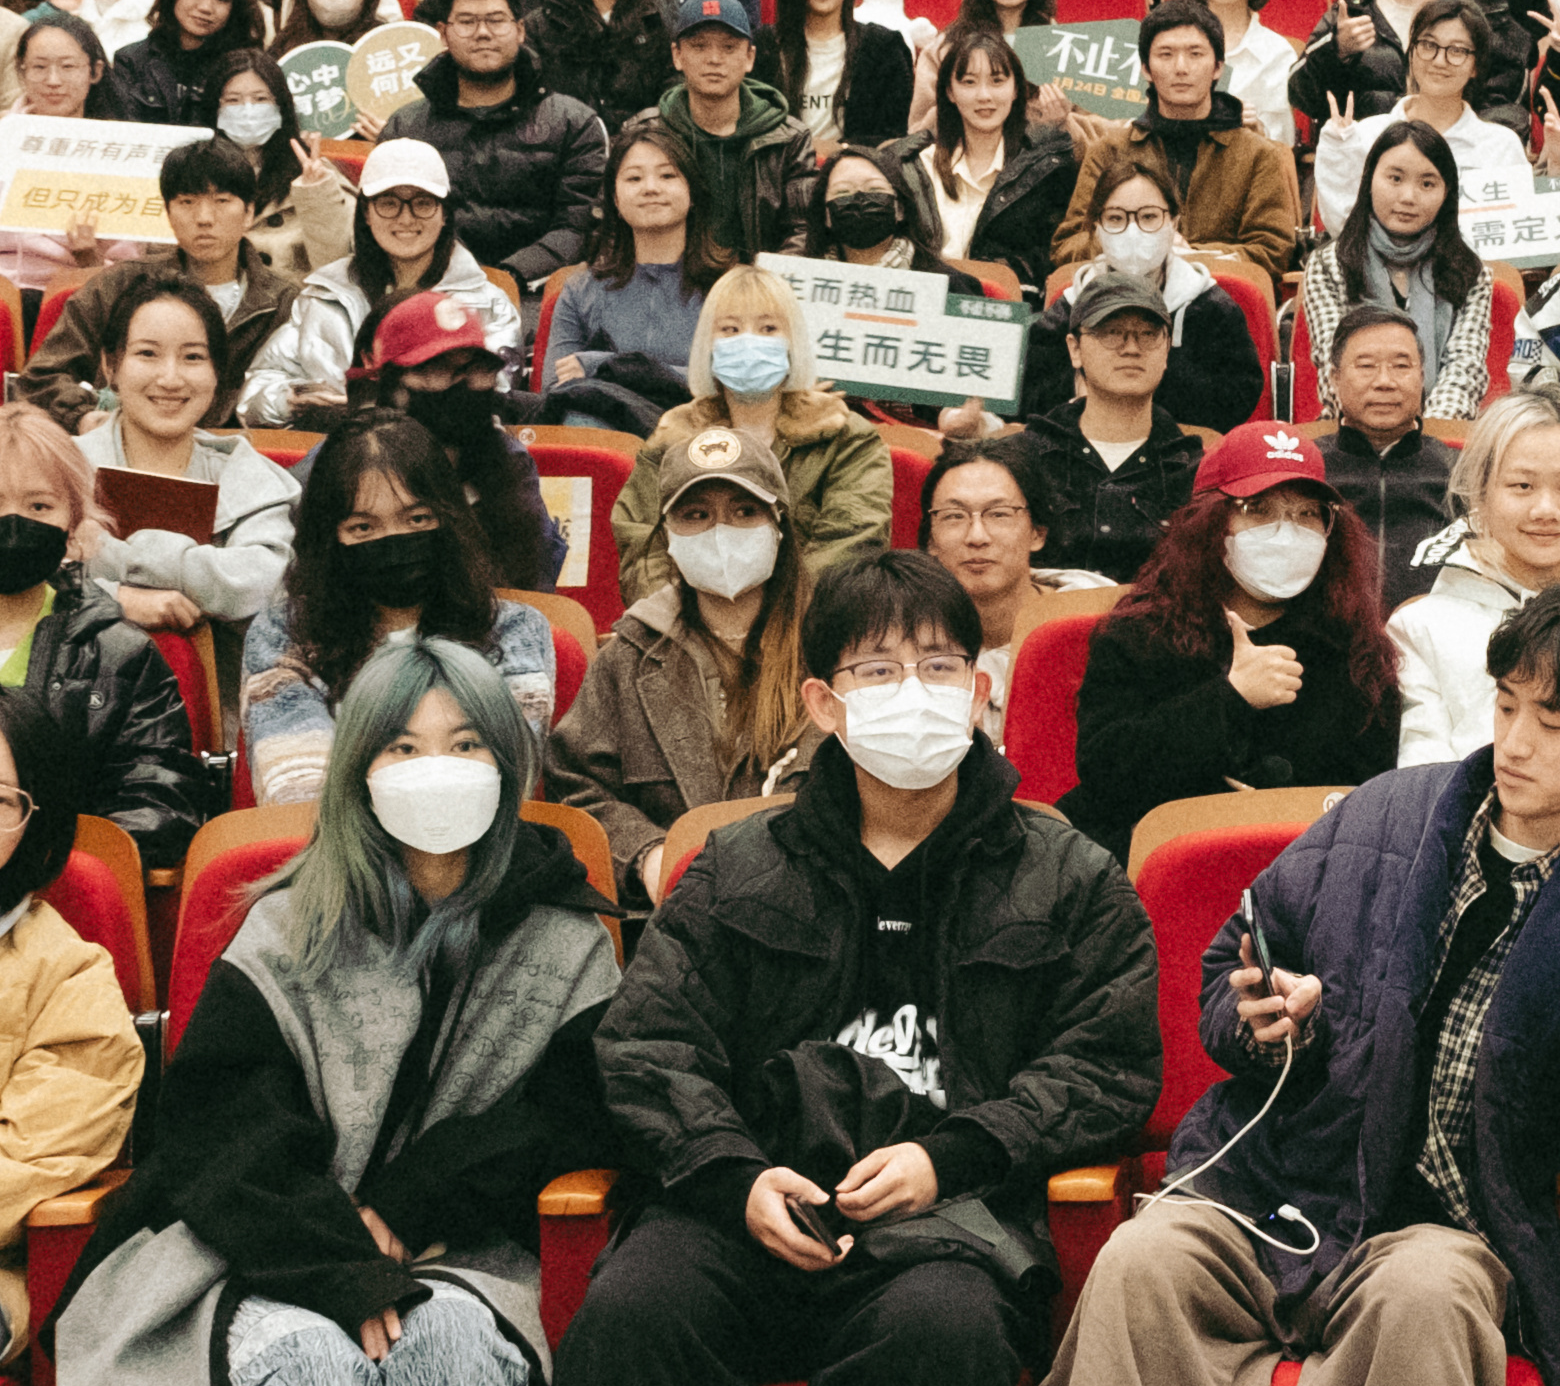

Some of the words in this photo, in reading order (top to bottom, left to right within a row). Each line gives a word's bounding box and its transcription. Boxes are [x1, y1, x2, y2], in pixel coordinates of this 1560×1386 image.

[287, 64, 339, 95] 心中
[816, 328, 994, 381] 生而无畏
[1266, 449, 1305, 464] adidas
